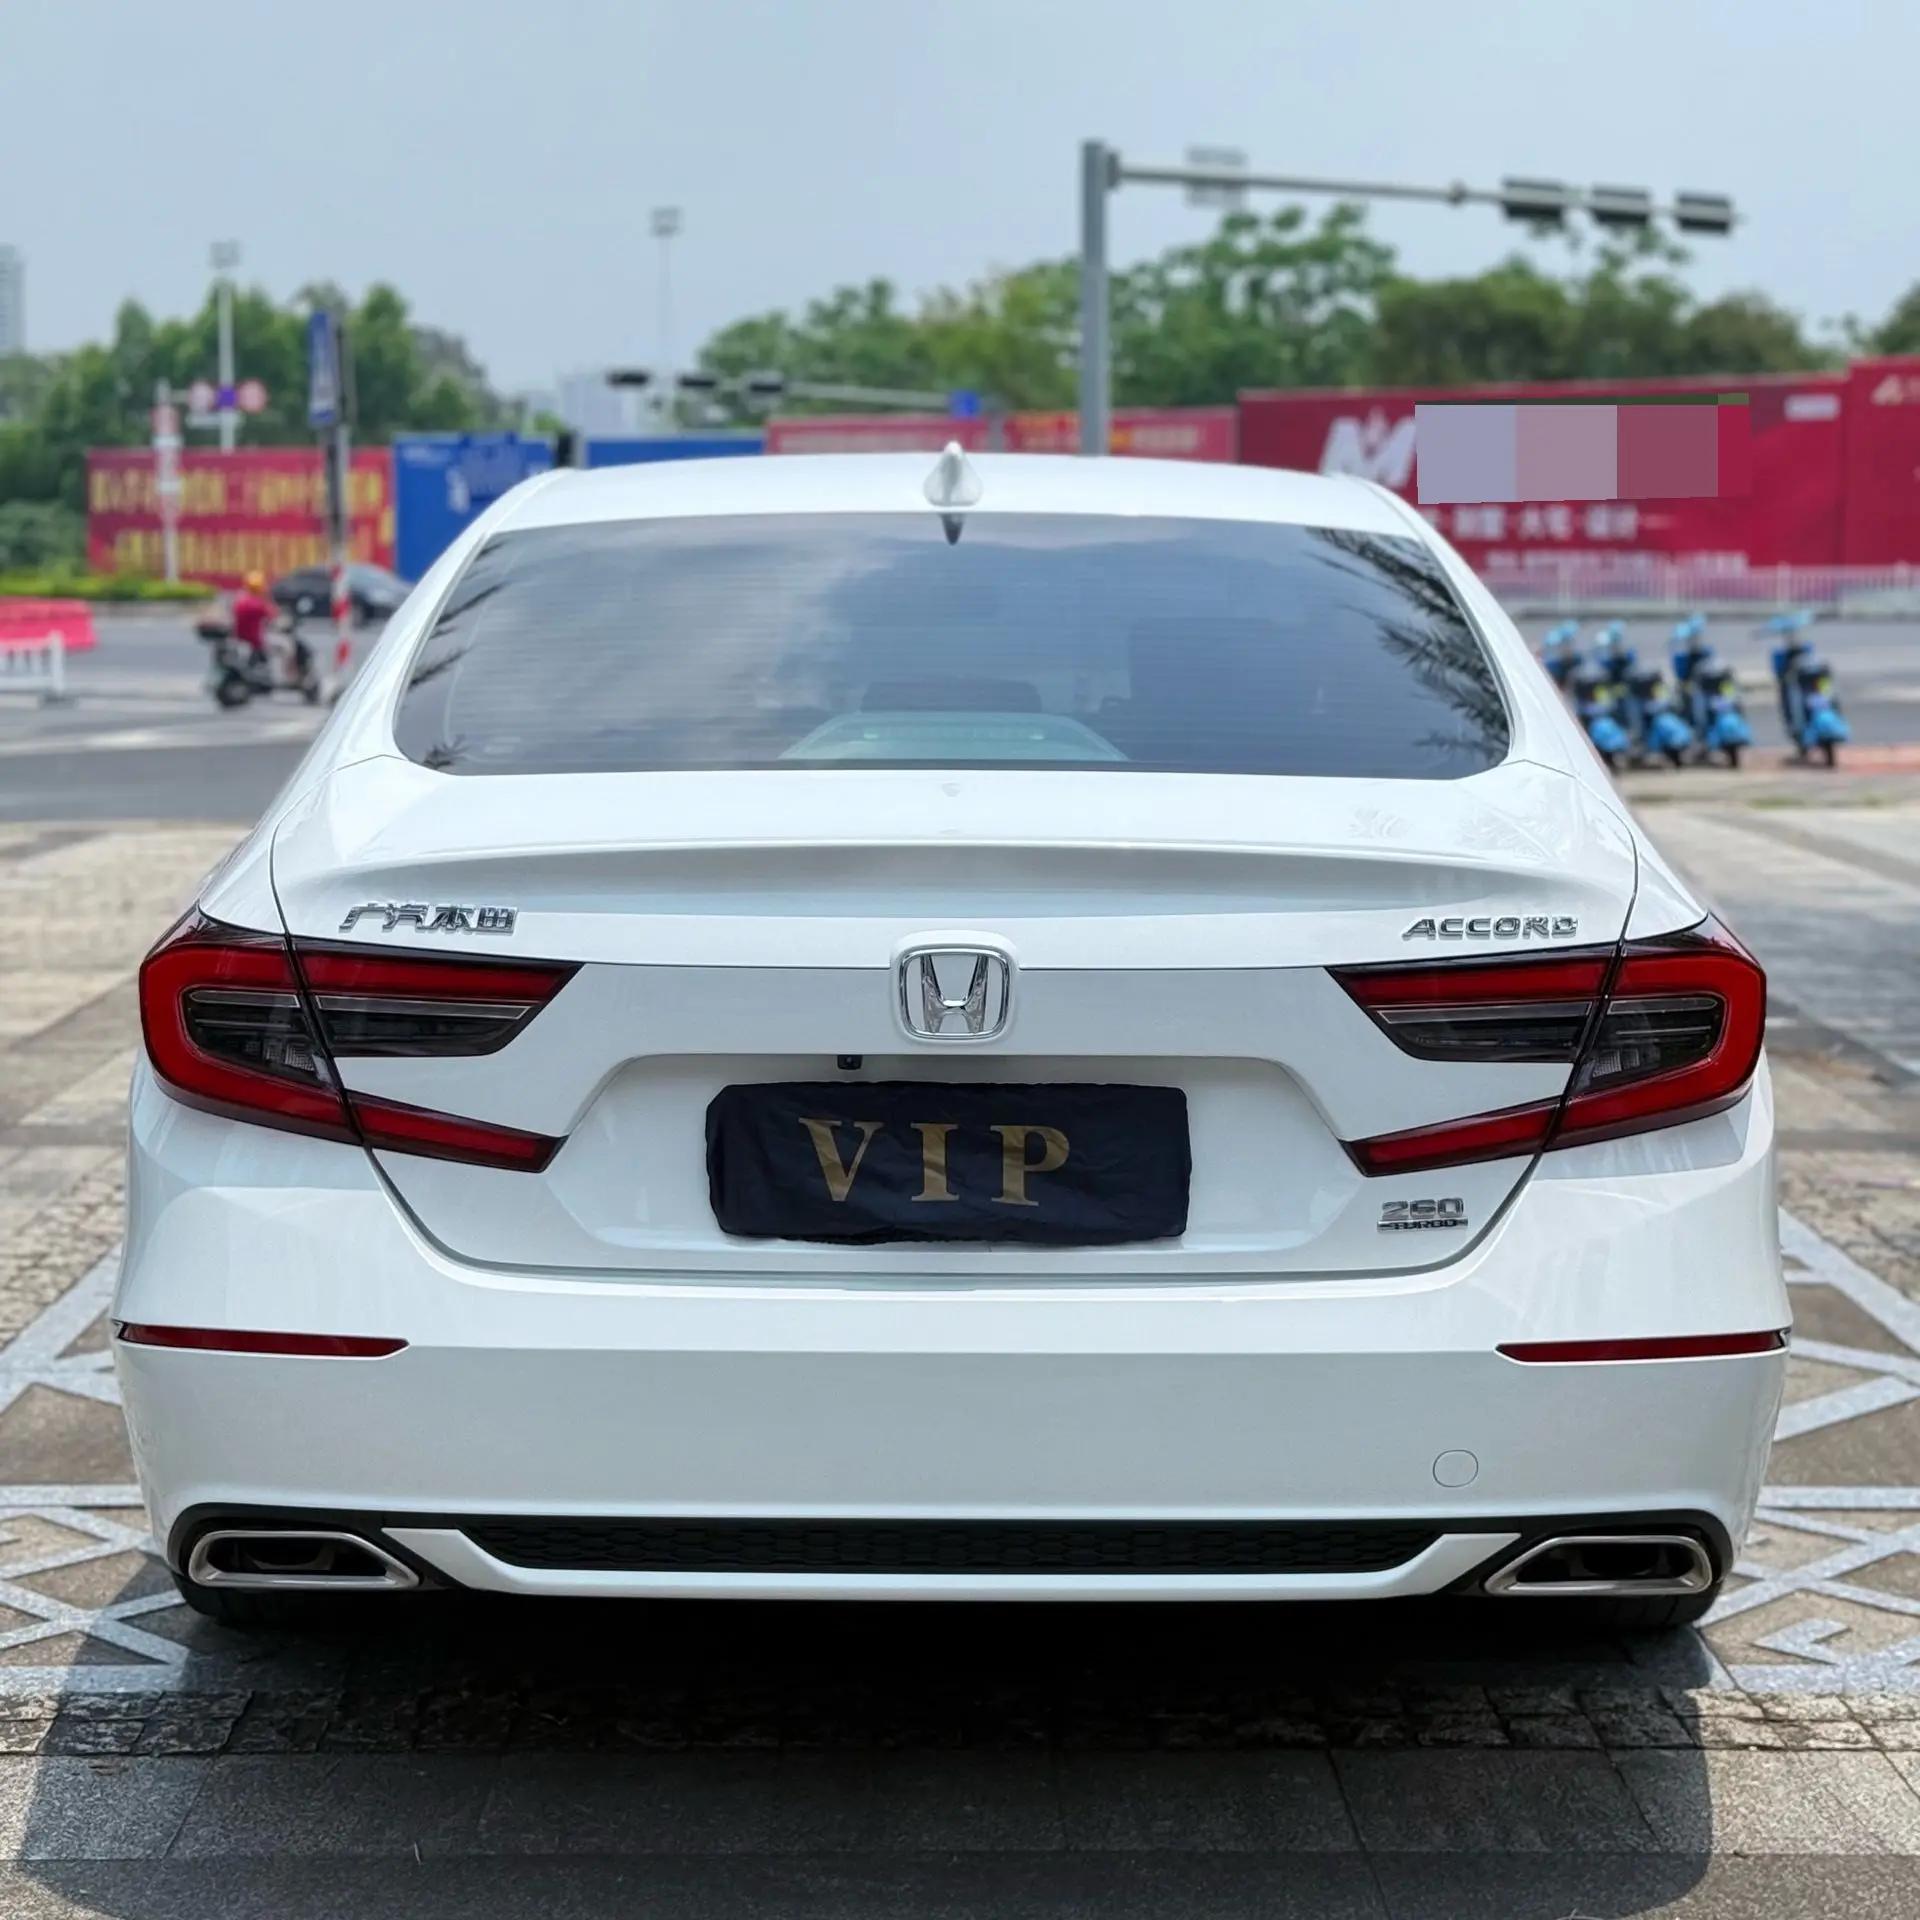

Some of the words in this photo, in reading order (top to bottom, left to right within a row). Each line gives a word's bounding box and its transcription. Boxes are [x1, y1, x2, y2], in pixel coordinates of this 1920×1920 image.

[338, 902, 518, 934] 广汽本田
[1402, 916, 1578, 940] ACCORD
[798, 1117, 1070, 1206] VIP
[1381, 1198, 1464, 1220] 260
